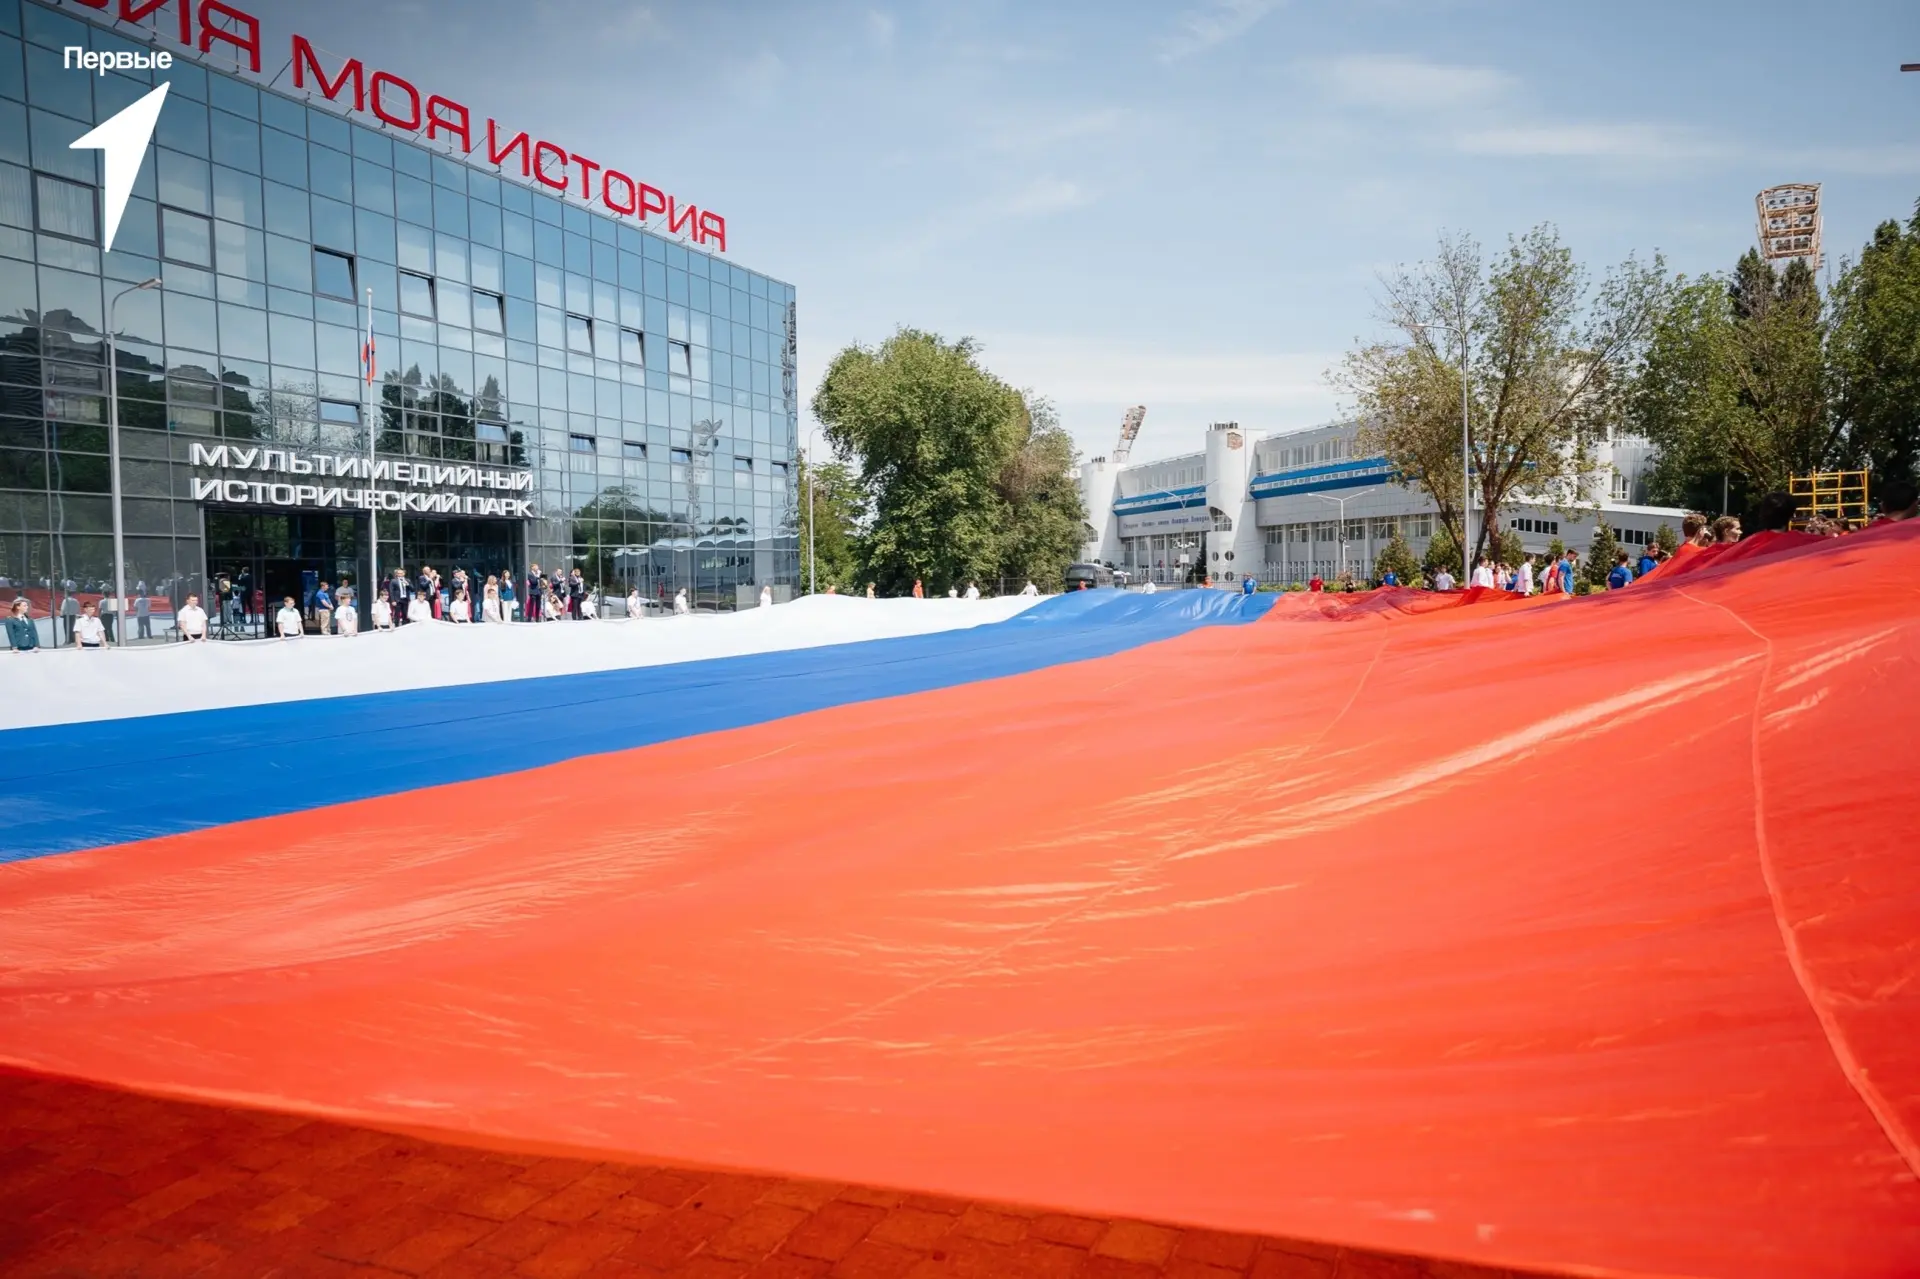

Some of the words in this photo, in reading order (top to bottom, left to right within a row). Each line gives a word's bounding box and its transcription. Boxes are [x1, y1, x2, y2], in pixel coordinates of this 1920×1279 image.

[78, 0, 260, 72] ИЯ
[292, 34, 471, 153] МОЯ
[487, 118, 726, 252] ИСТОРИЯ
[189, 442, 534, 491] МУЛЬТИМЕДИЙНЫЙ
[190, 477, 461, 514] ИСТОРИЧЕСКИЙ
[465, 495, 534, 518] ПАРК
